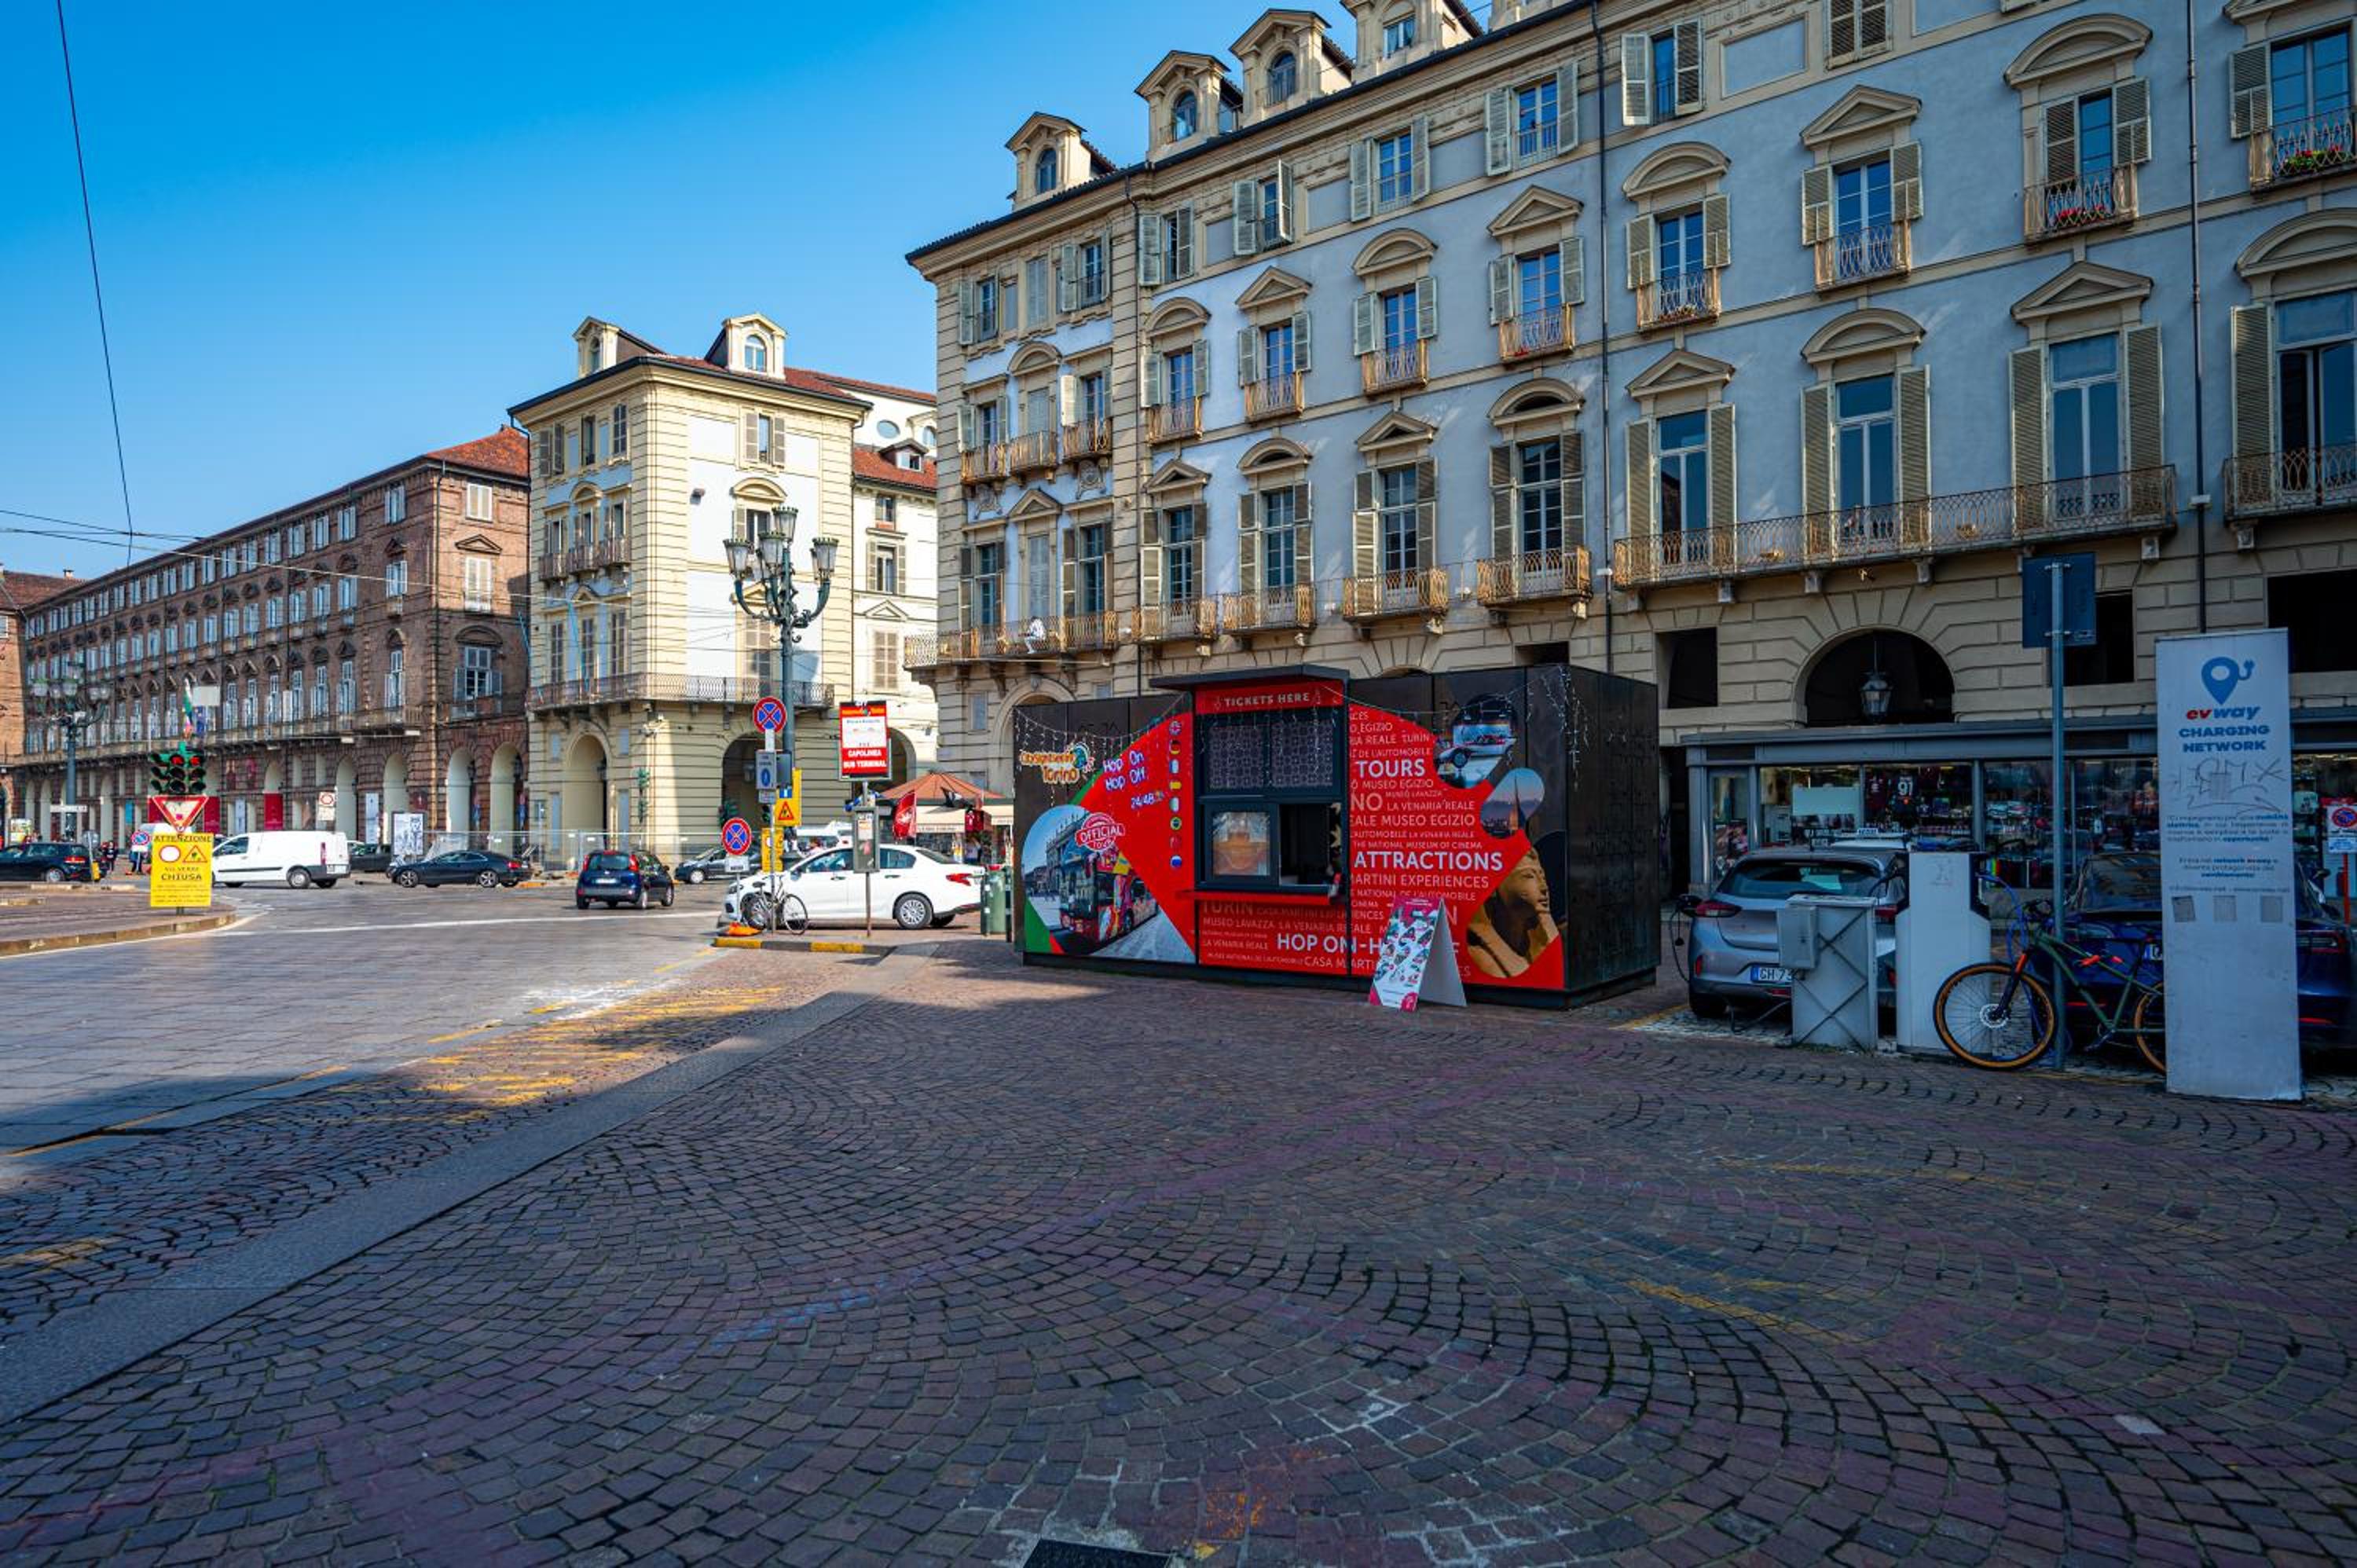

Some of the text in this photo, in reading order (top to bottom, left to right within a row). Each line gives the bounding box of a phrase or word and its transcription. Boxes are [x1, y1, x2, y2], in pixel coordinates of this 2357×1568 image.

[1224, 692, 1310, 706] TICKETS HERE
[2186, 706, 2261, 720] evway
[1360, 722, 1393, 733] EGIZIO
[2178, 725, 2271, 738] CHARGING
[1365, 735, 1397, 746] REALE
[2183, 740, 2267, 753] NETWORK
[848, 749, 882, 757] CAPOLINEA
[1355, 759, 1426, 778] TOURS
[1362, 779, 1398, 789] MUSEO
[1399, 779, 1434, 789] EGIZIO
[1386, 800, 1475, 811] LA VENARIA REALE
[1381, 815, 1427, 826] MUSEO
[1431, 814, 1475, 826] EGIZIO
[1080, 826, 1124, 844] OFFICIAL
[1368, 841, 1404, 849] NATIONAL
[1406, 841, 1439, 849] MUSEUM
[1451, 841, 1483, 850] CINEMA
[1354, 851, 1503, 871] ATTRACTIONS
[1350, 874, 1490, 888] ARTINI EXPERIENCES
[1203, 917, 1234, 927] MUSEO
[1235, 918, 1276, 929] LAVAZZA
[1278, 920, 1291, 930] LA
[1293, 921, 1334, 932] VENARIA
[1276, 932, 1318, 952] HOP
[1304, 956, 1333, 968] CASA
